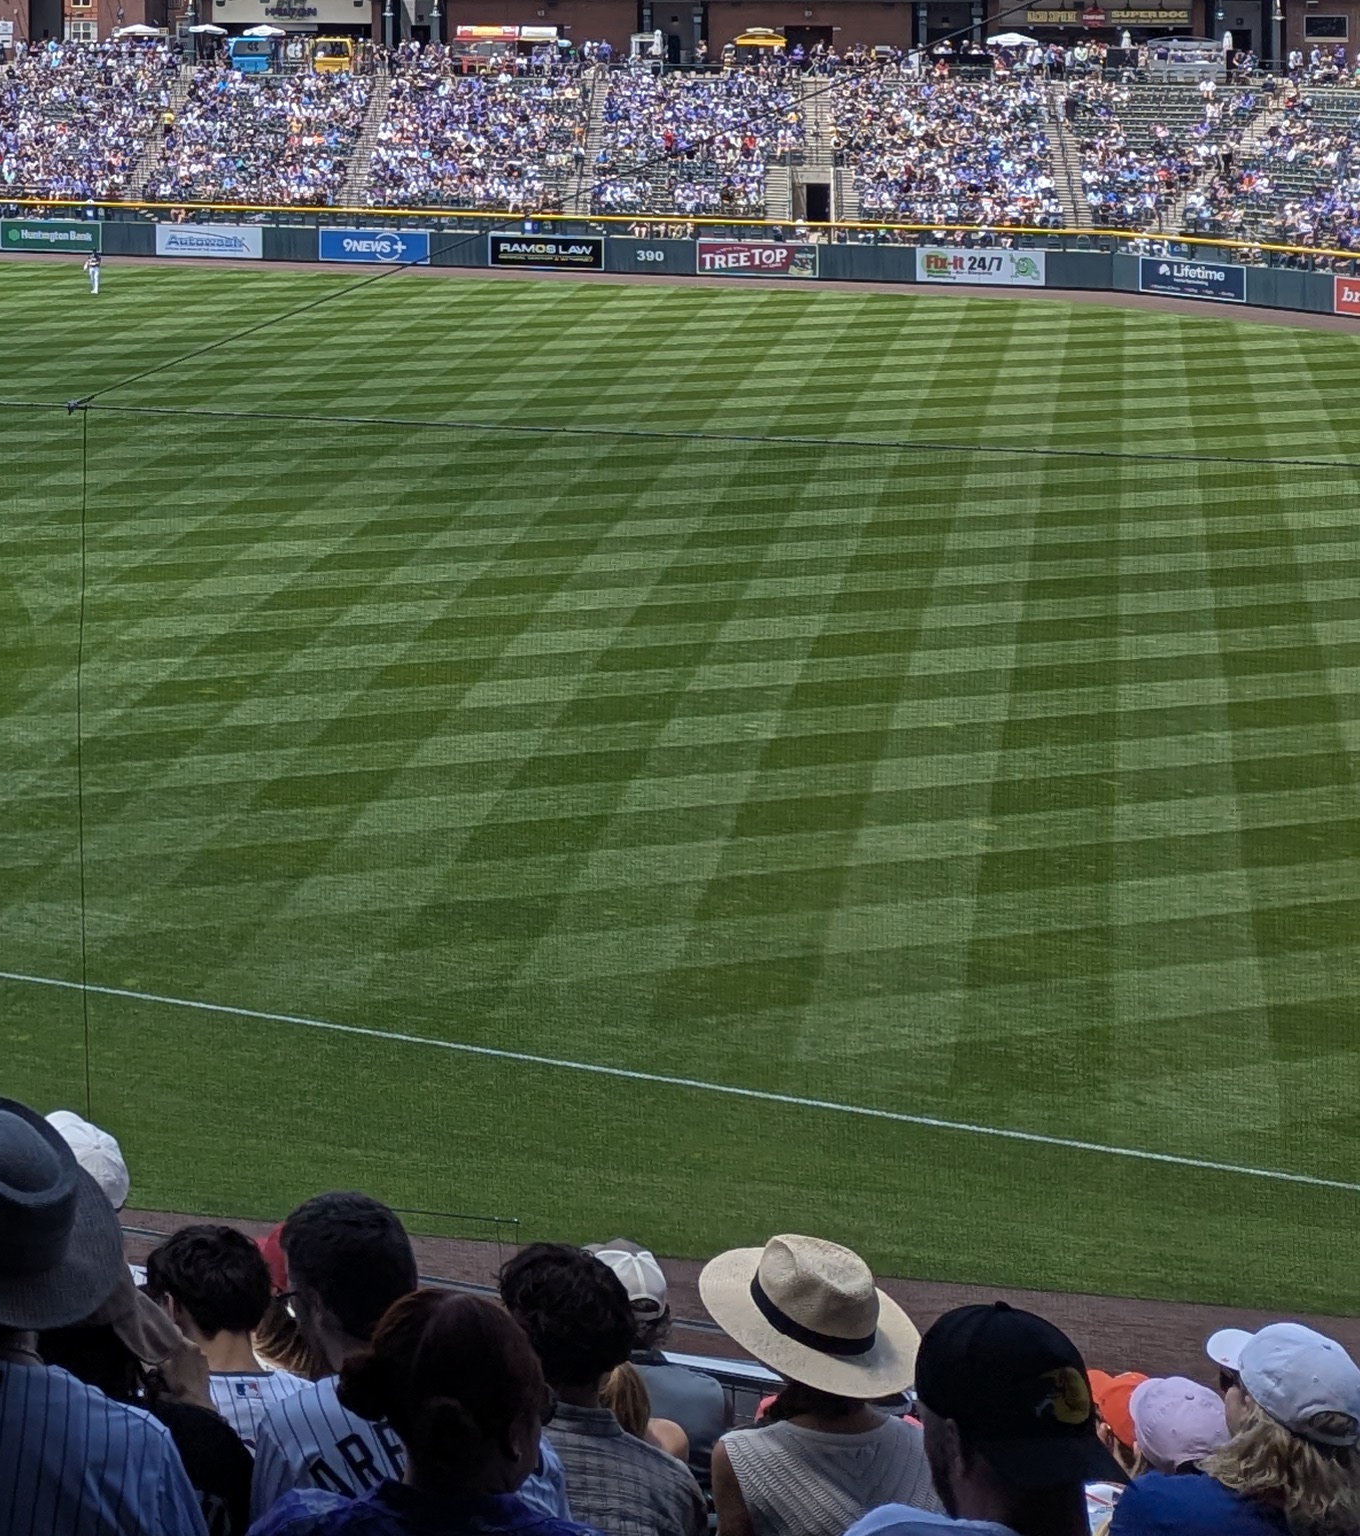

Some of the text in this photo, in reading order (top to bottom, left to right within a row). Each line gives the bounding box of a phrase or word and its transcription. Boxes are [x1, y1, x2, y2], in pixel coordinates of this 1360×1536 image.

[1111, 10, 1160, 19] SUPER
[1160, 10, 1189, 18] DOG
[69, 231, 92, 242] Bank
[165, 235, 245, 249] Autowash
[499, 243, 593, 255] RAMOS LAW
[636, 250, 665, 262] 390
[701, 248, 788, 270] TREE TOP
[925, 254, 1003, 271] Fix-it 24/7
[1173, 264, 1225, 282] Lifetime
